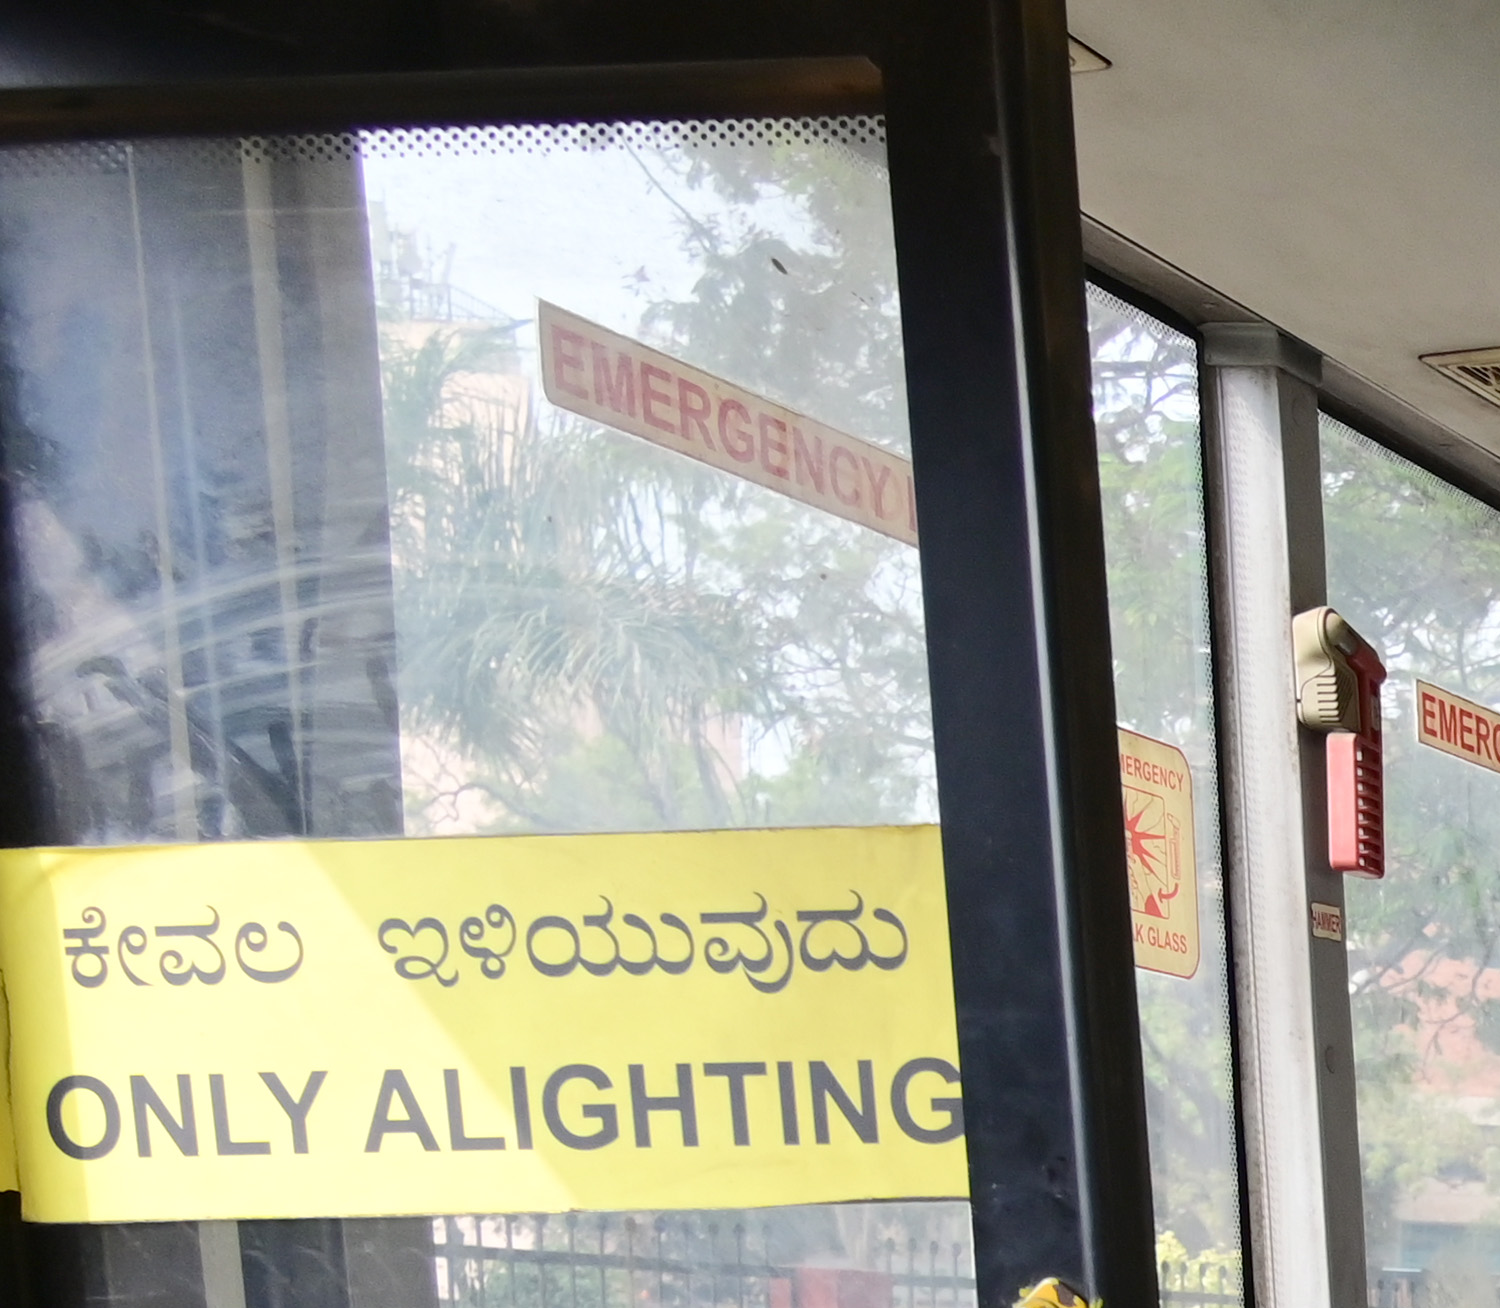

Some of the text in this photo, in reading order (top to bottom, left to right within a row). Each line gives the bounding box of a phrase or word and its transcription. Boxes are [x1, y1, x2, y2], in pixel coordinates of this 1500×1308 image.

[550, 324, 891, 520] EMERGENCY
[1121, 754, 1184, 792] ERGENCY
[62, 888, 909, 994] ಕೇವಲ ಇಳಿಯುವುದು
[1147, 926, 1188, 954] GLASS
[45, 1056, 966, 1159] ONLY ALIGHTING
